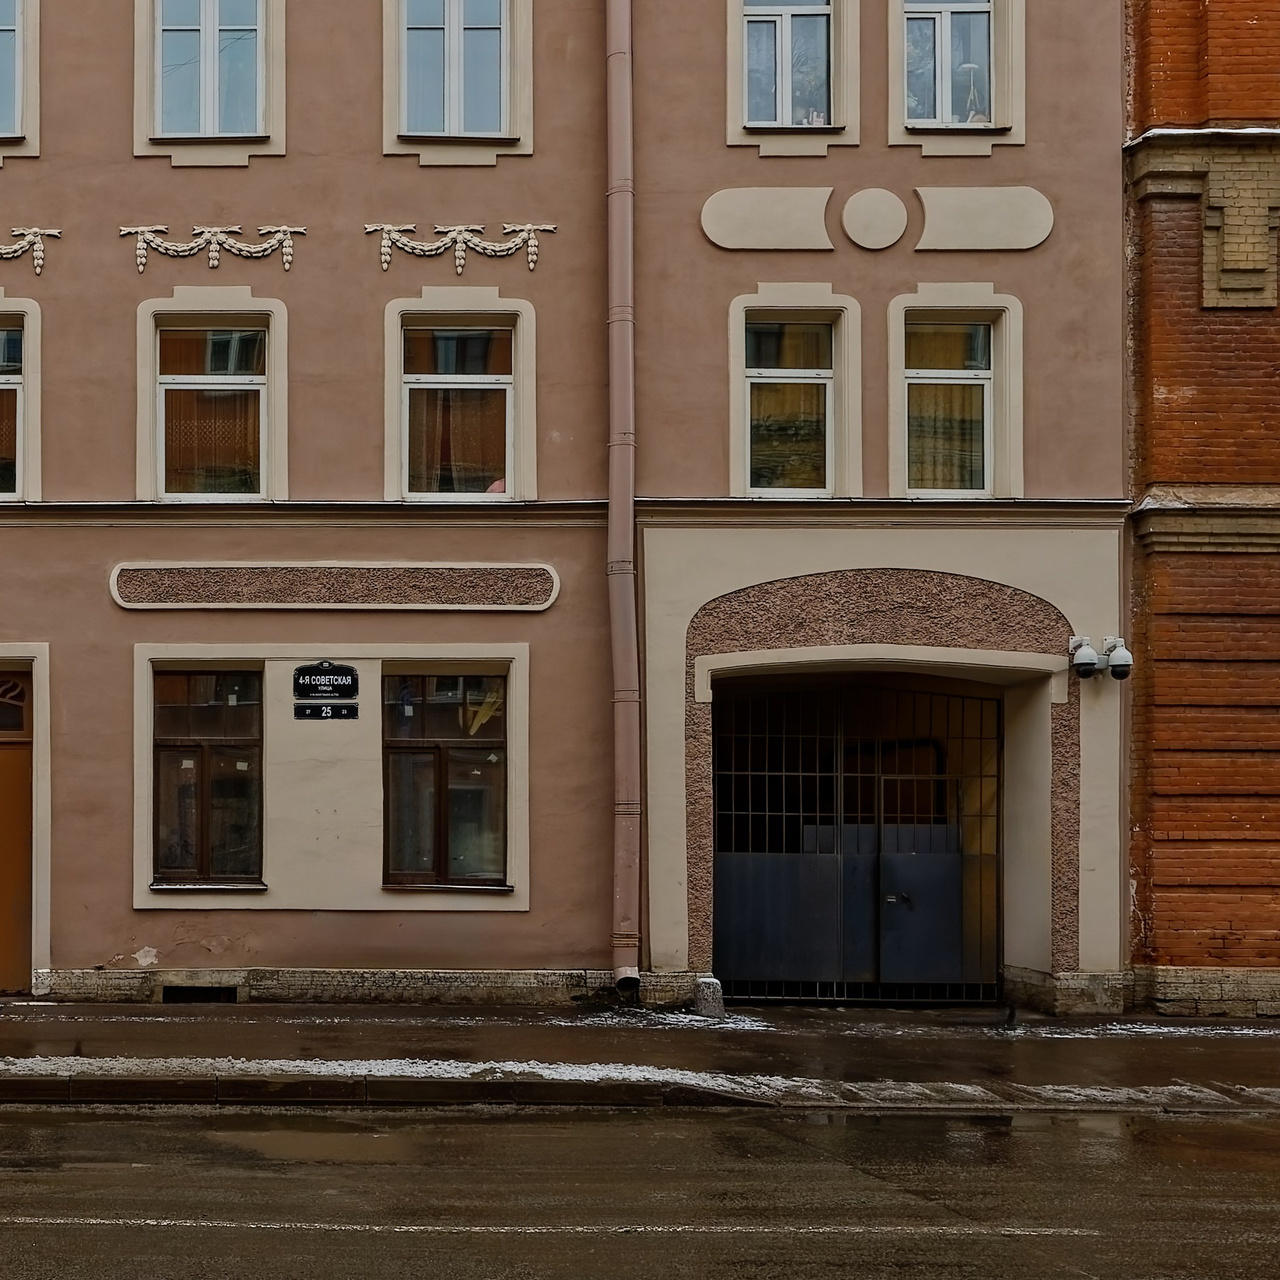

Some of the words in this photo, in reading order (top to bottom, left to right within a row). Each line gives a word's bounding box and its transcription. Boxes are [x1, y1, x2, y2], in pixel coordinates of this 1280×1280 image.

[299, 676, 310, 684] 4-Я
[311, 676, 351, 684] СОВЕТСКАЯ
[321, 706, 332, 716] 25
